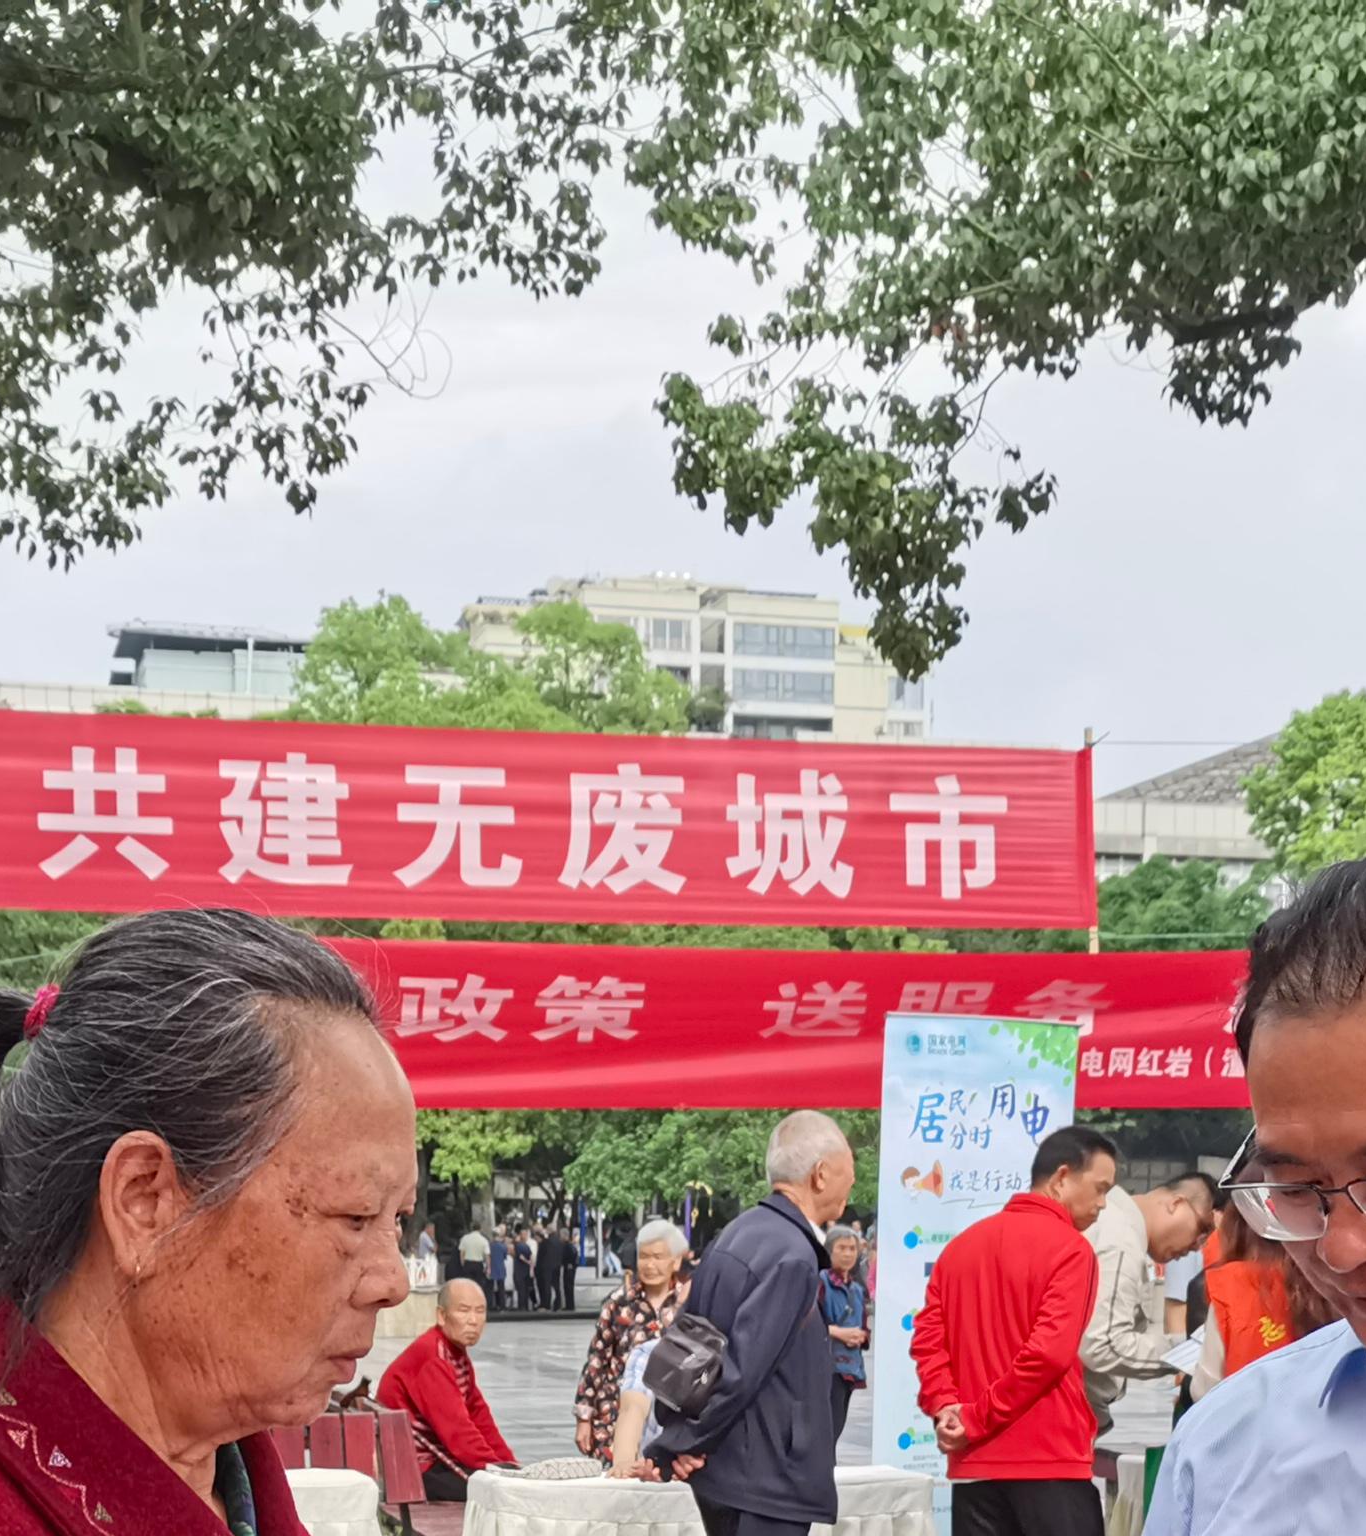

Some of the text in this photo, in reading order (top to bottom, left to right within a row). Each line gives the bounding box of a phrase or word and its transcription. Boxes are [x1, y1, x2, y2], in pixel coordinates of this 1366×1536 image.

[36, 745, 1009, 901] 共建无废城市
[393, 972, 647, 1045] 政策
[949, 1168, 1032, 1193] 我是行动
